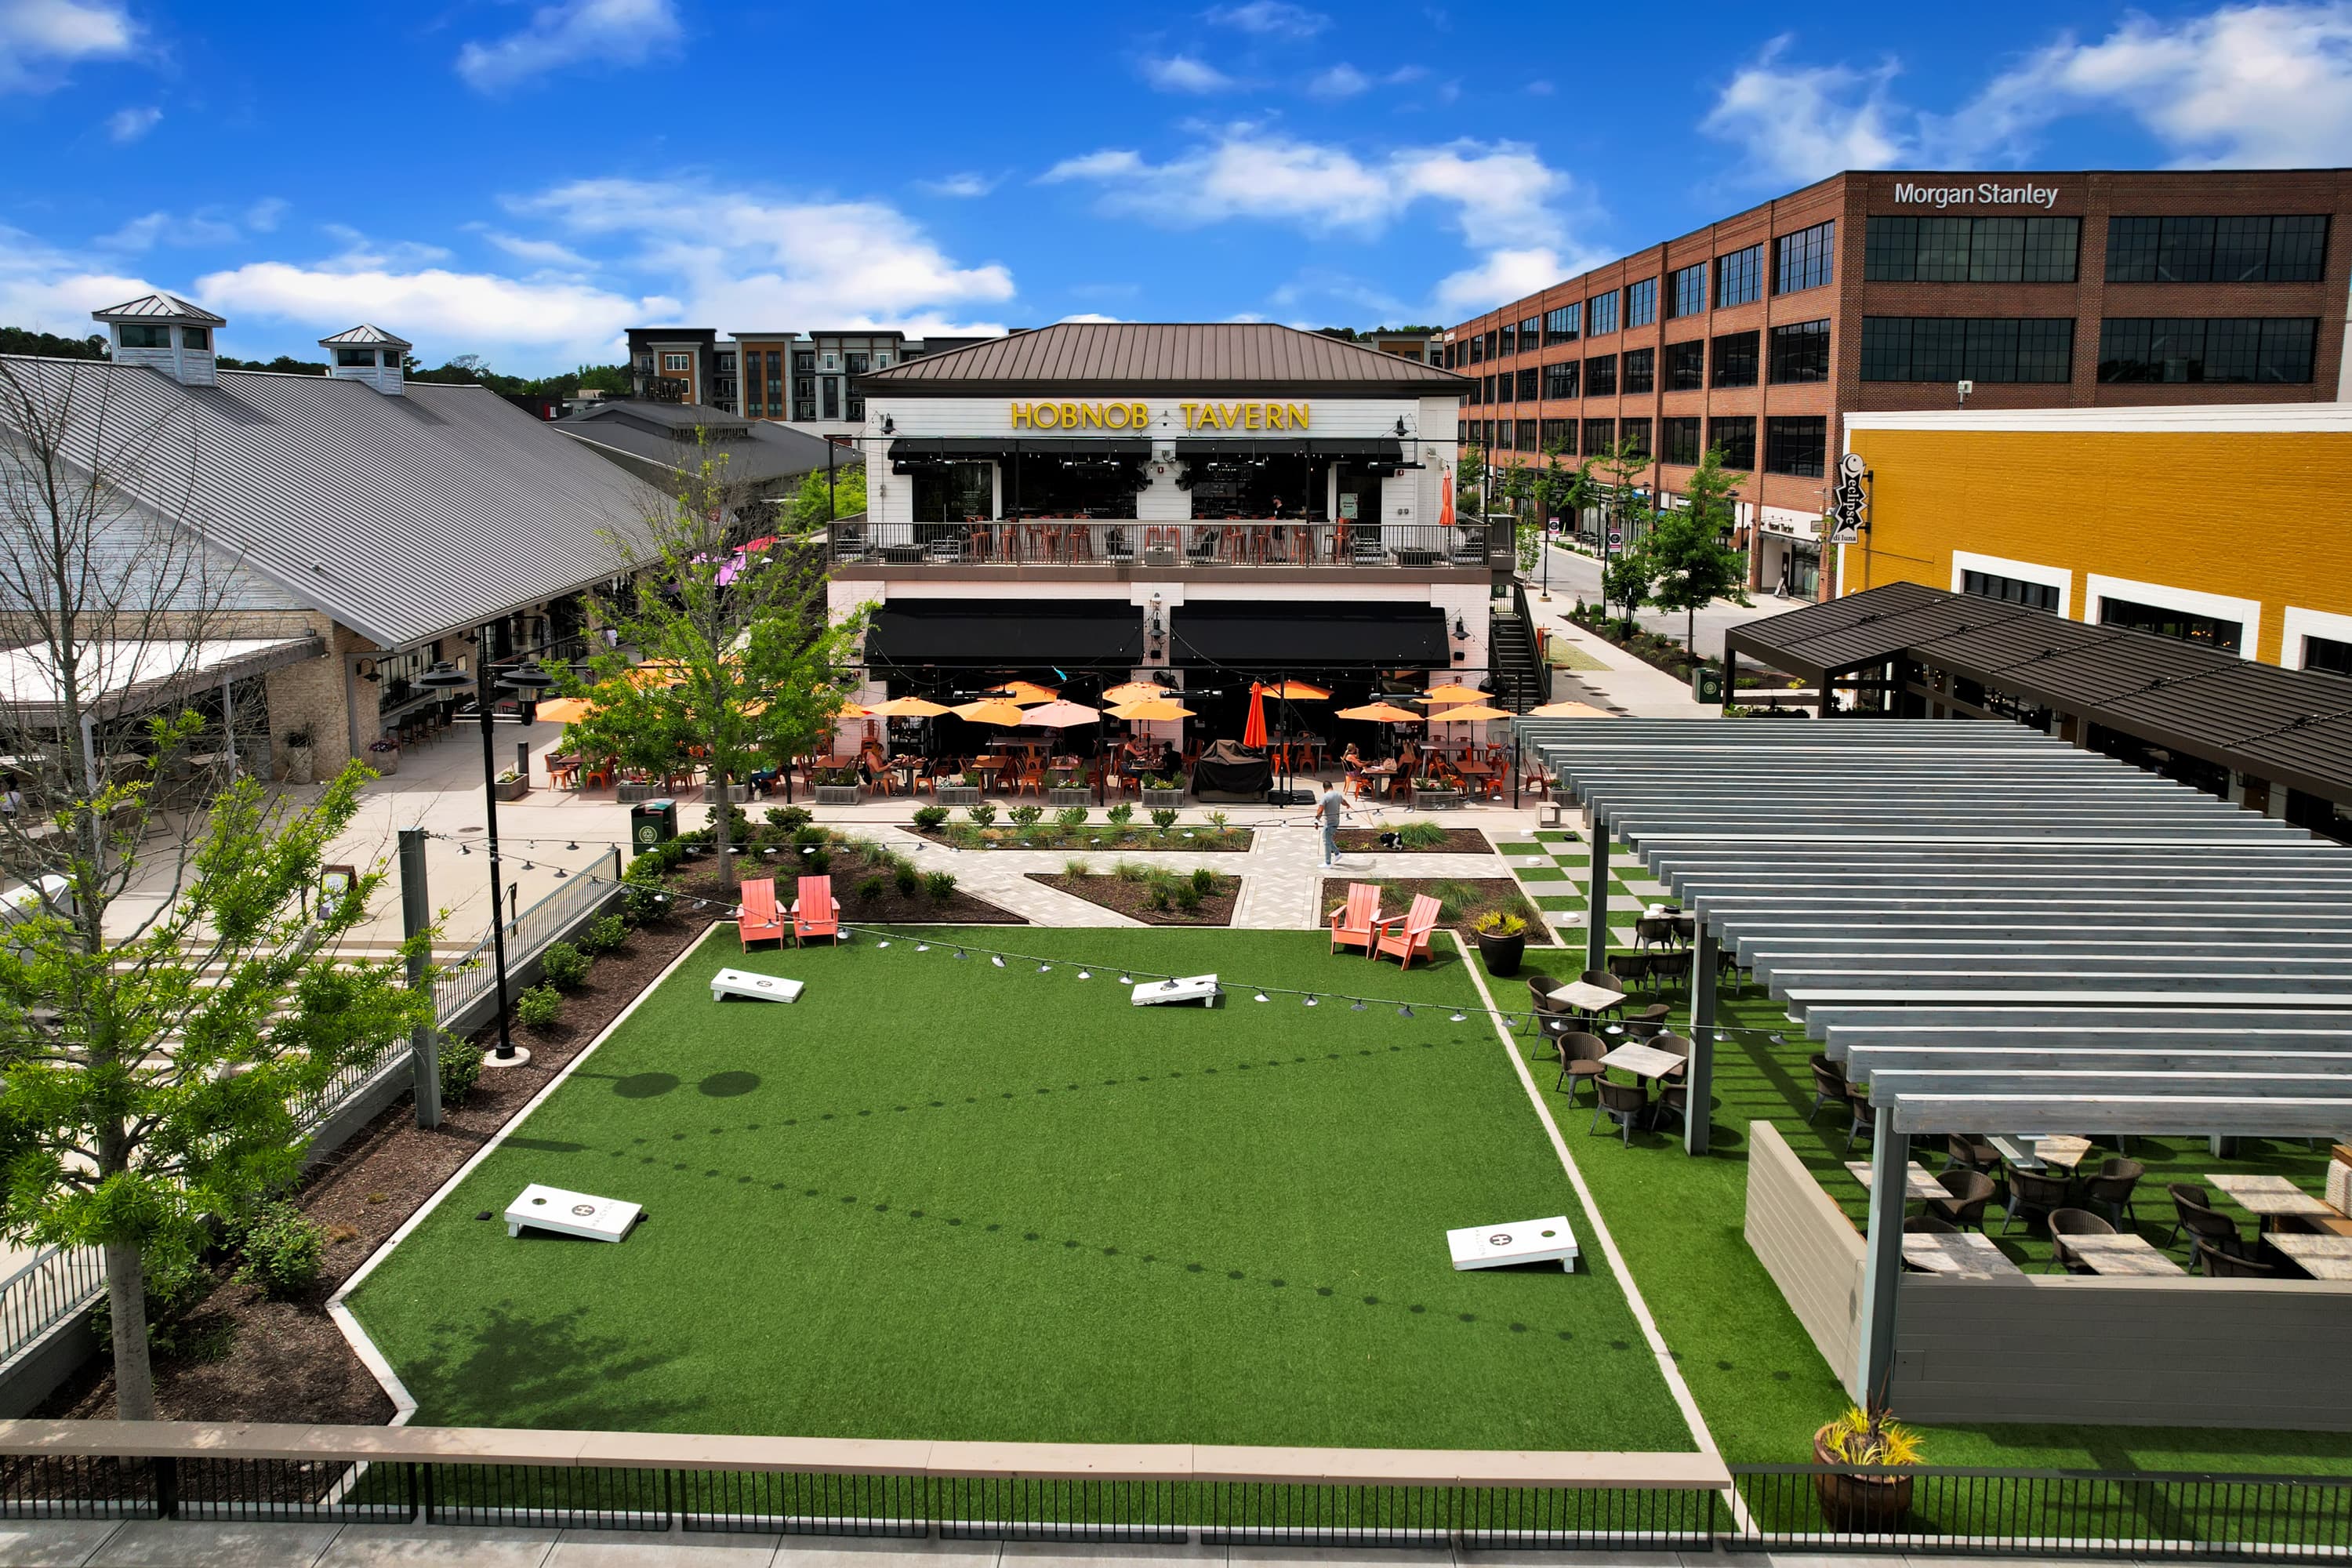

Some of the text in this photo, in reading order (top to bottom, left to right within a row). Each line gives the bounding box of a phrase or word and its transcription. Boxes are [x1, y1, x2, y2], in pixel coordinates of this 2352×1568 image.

[1894, 183, 2059, 209] Morgan Stanley
[1011, 402, 1310, 430] HOBNOB TAVERN
[1843, 479, 1860, 524] eclipse
